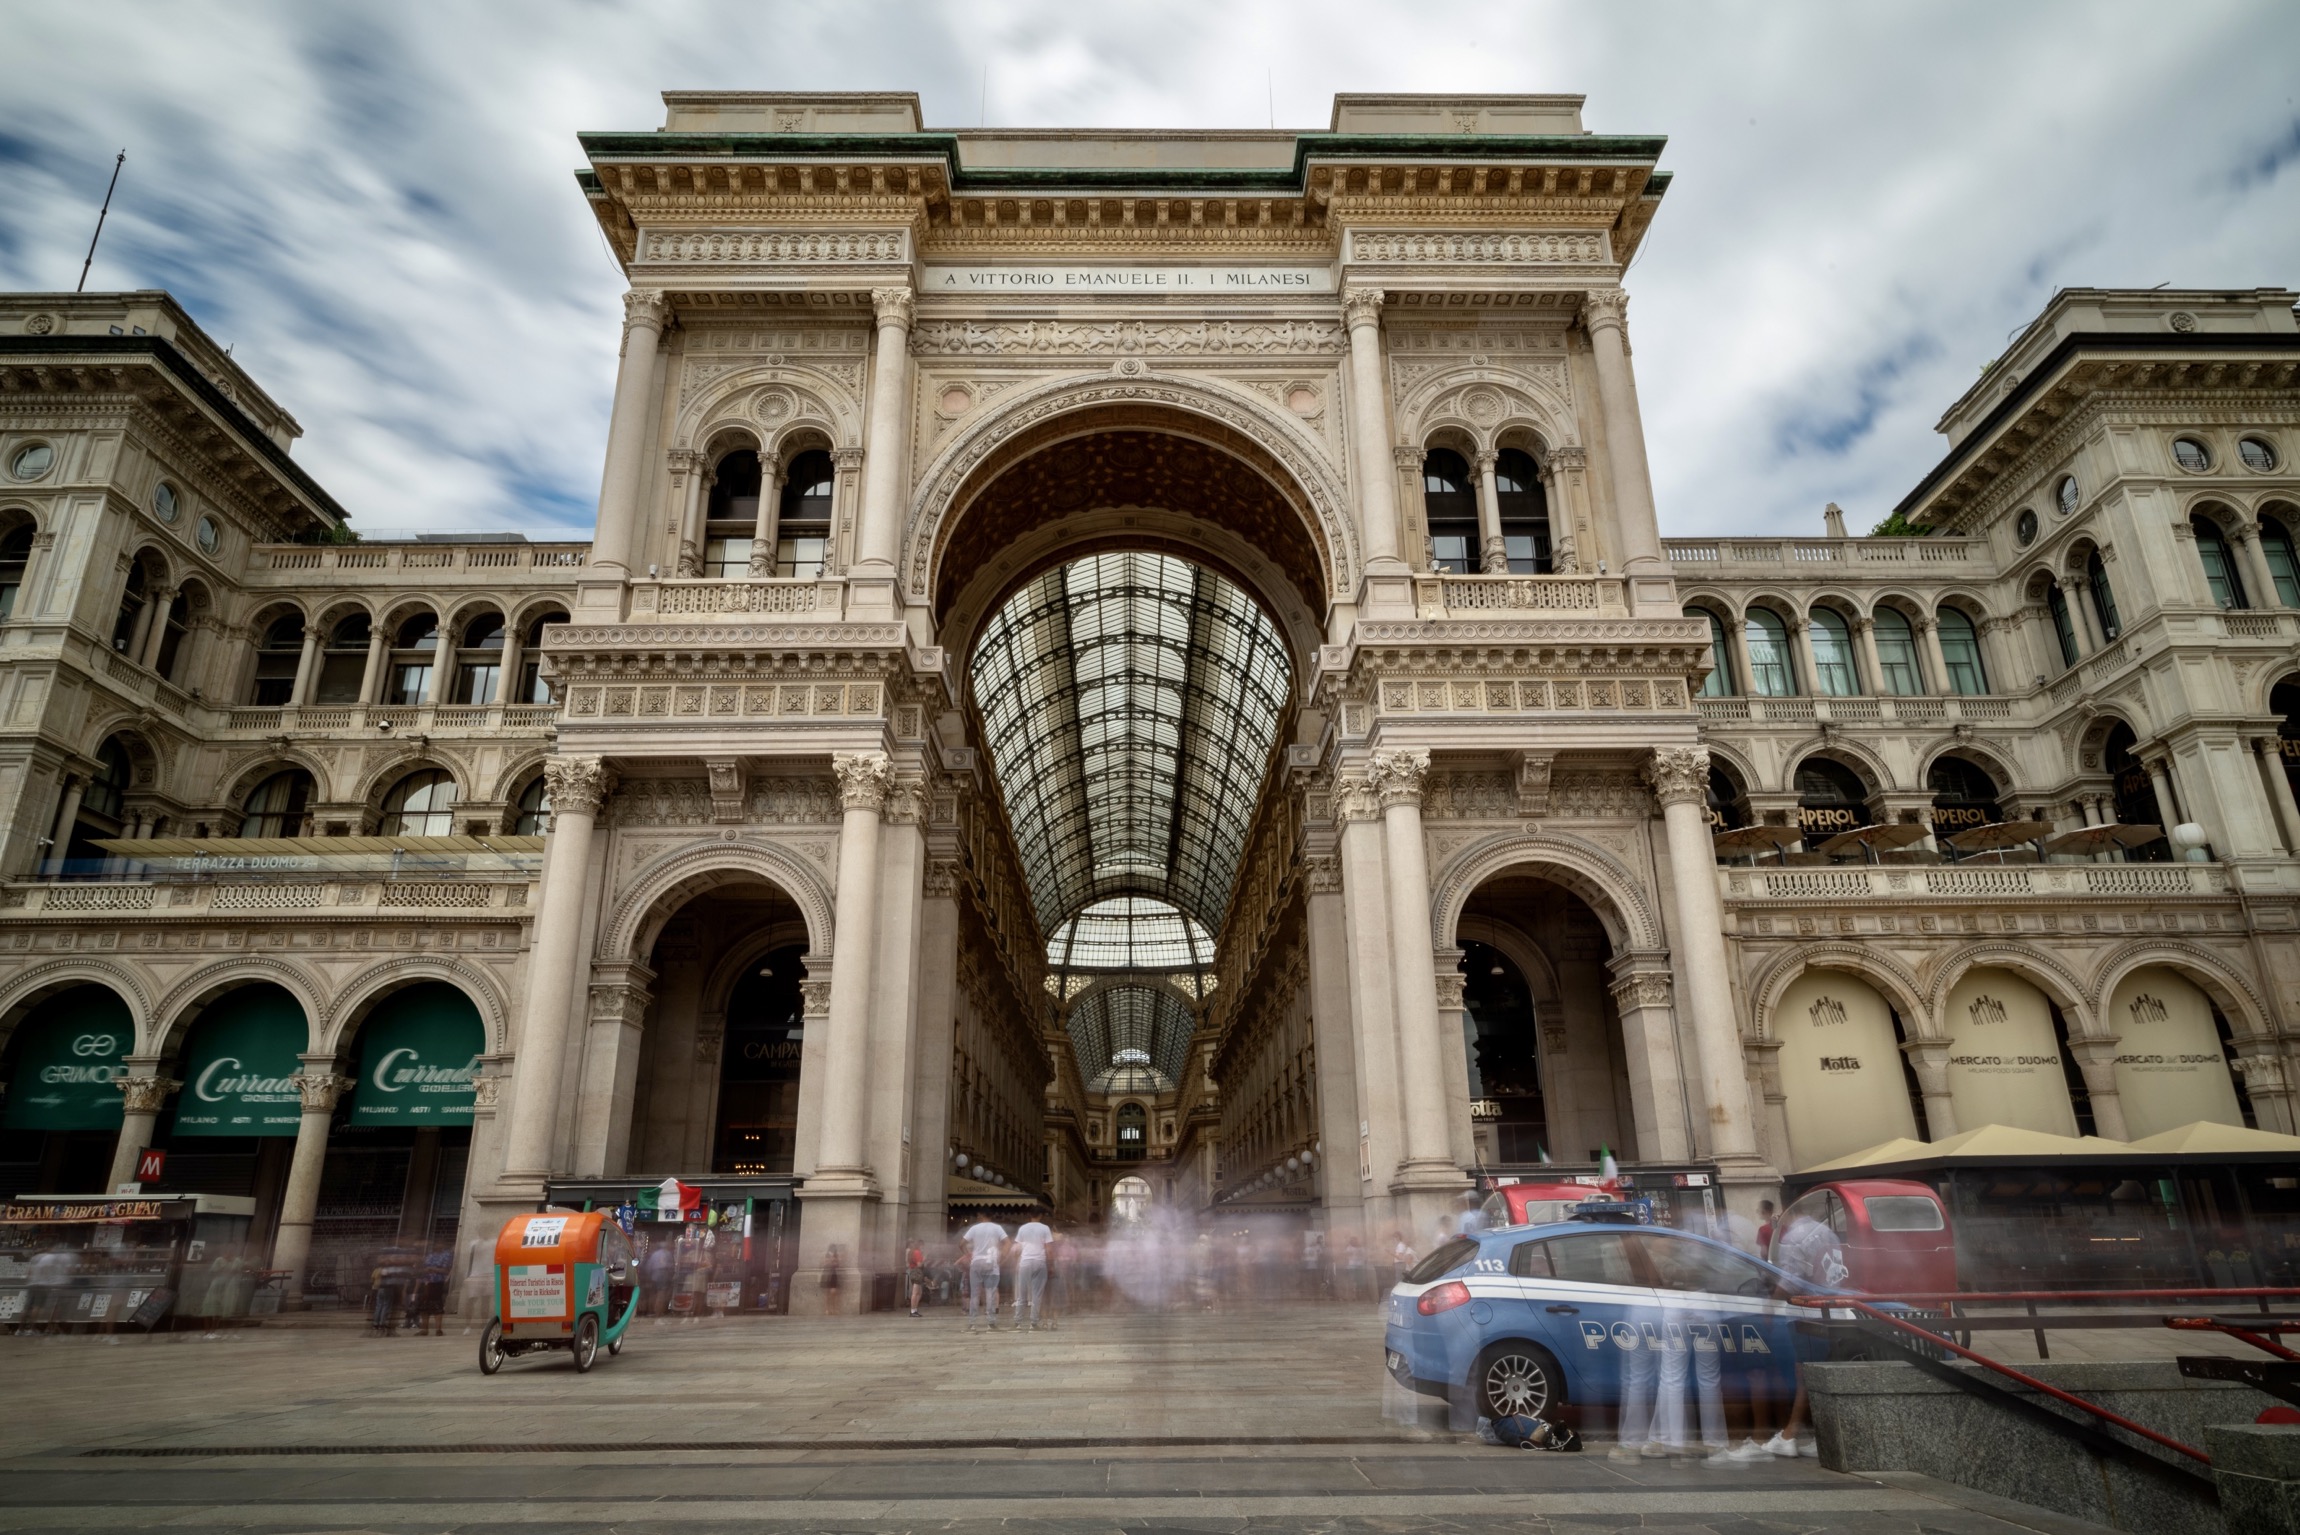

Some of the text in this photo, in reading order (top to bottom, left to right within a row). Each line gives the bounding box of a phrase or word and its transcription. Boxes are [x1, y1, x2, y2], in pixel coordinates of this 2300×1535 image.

[945, 273, 957, 285] A
[969, 273, 1054, 285] VITTORIO
[1065, 273, 1167, 285] EMANUELE
[1178, 273, 1194, 285] II.
[1226, 273, 1310, 285] MILANESI
[2123, 771, 2149, 797] APE
[1798, 806, 1860, 825] APEROL
[175, 857, 245, 870] TERRAZZA
[251, 856, 298, 869] DUOMO
[744, 1041, 801, 1059] CAMPA
[1819, 1056, 1862, 1071] Motta
[1950, 1056, 2002, 1065] MERCATO
[2017, 1056, 2059, 1065] DUOMO
[2113, 1055, 2164, 1064] MERCATO
[2179, 1054, 2222, 1064] DUOMO
[195, 1057, 304, 1102] Currad
[1470, 1100, 1503, 1117] otta
[179, 1116, 219, 1124] MILANO
[263, 1116, 302, 1124] SANREM
[140, 1156, 161, 1176] M
[6, 1205, 56, 1220] CREAM
[1474, 1259, 1506, 1272] 113
[1579, 1320, 1772, 1354] POLIZIA
